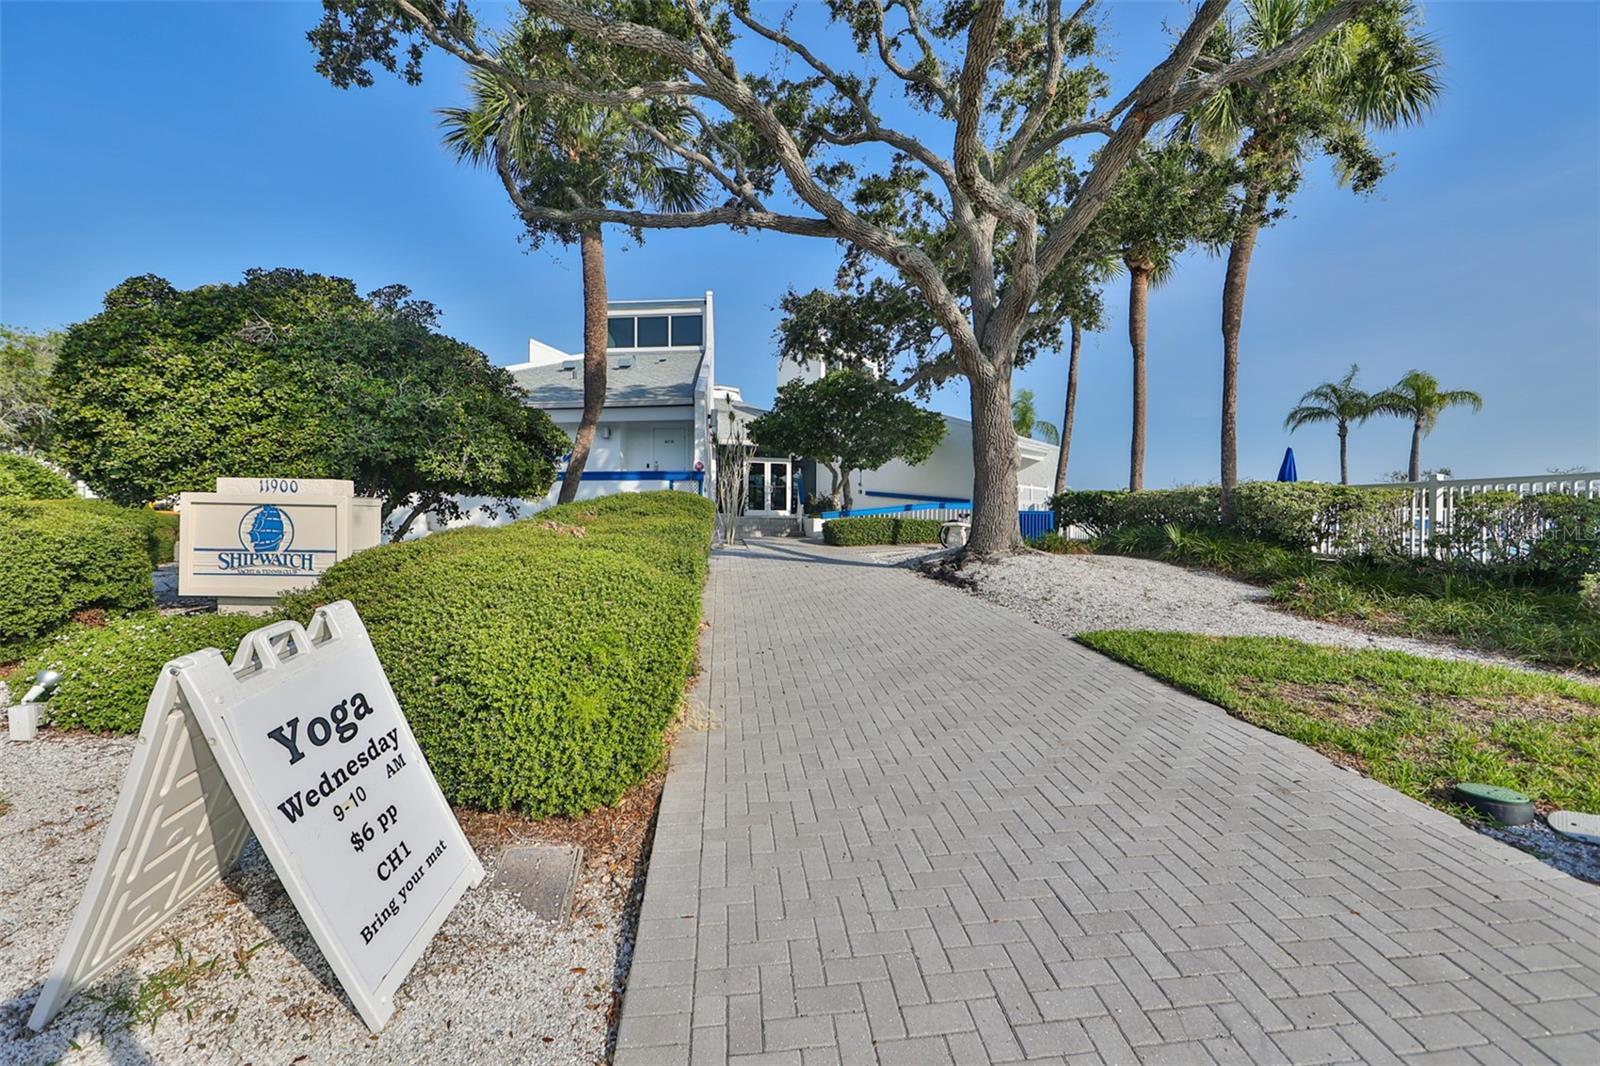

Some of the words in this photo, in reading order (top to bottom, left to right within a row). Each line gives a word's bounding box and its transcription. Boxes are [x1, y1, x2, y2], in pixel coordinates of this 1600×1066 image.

[259, 479, 299, 494] 11900
[217, 552, 314, 571] SHIPWATCH
[267, 692, 374, 766] Yoga
[276, 727, 399, 824] Wednesday
[332, 785, 367, 822] 9-10
[385, 753, 407, 779] AM
[349, 821, 375, 853] $6
[376, 803, 399, 834] pp
[376, 840, 412, 882] CH1
[359, 897, 401, 946] Bring
[397, 865, 425, 904] your
[425, 839, 448, 868] mat
